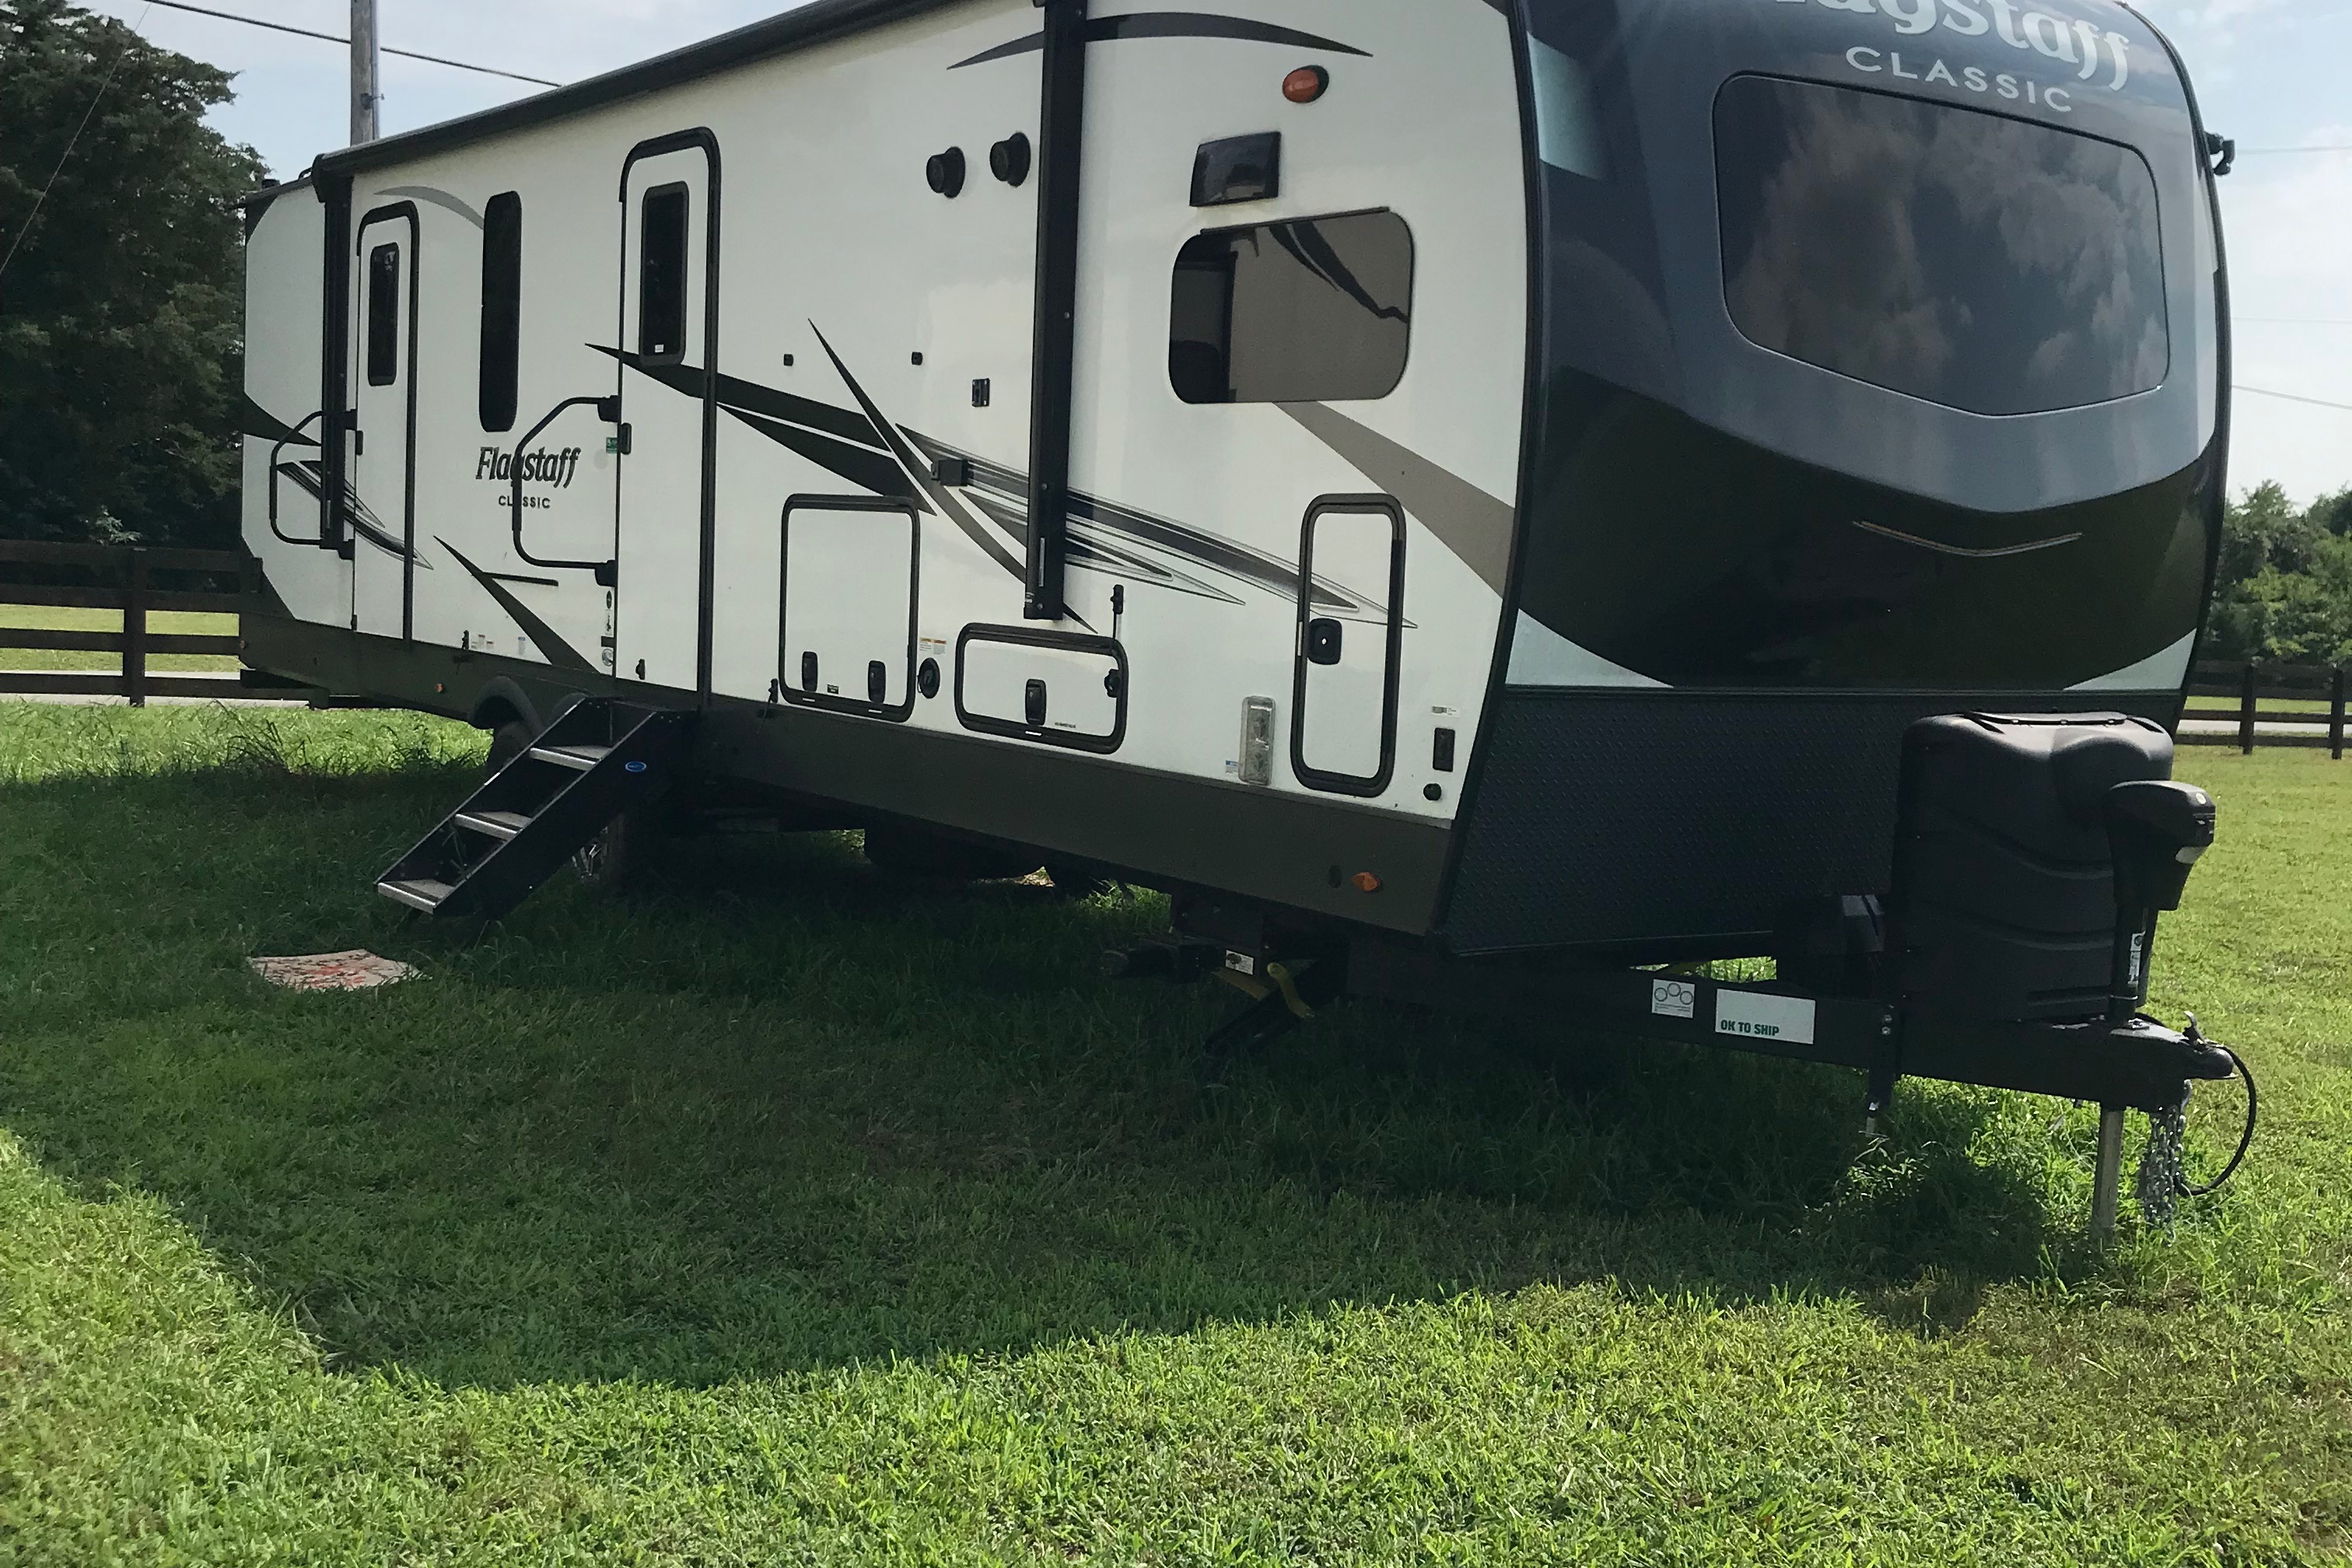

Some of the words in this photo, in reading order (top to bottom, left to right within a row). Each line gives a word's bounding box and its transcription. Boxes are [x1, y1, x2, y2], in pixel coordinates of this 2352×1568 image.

[1776, 0, 2130, 92] gstaff
[1845, 46, 2073, 113] CLASSIC
[475, 446, 582, 489] Flastaff
[498, 495, 551, 509] CLSSIC
[1720, 1019, 1736, 1031] OK
[1738, 1021, 1752, 1034] TO
[1754, 1024, 1780, 1036] SHIP
